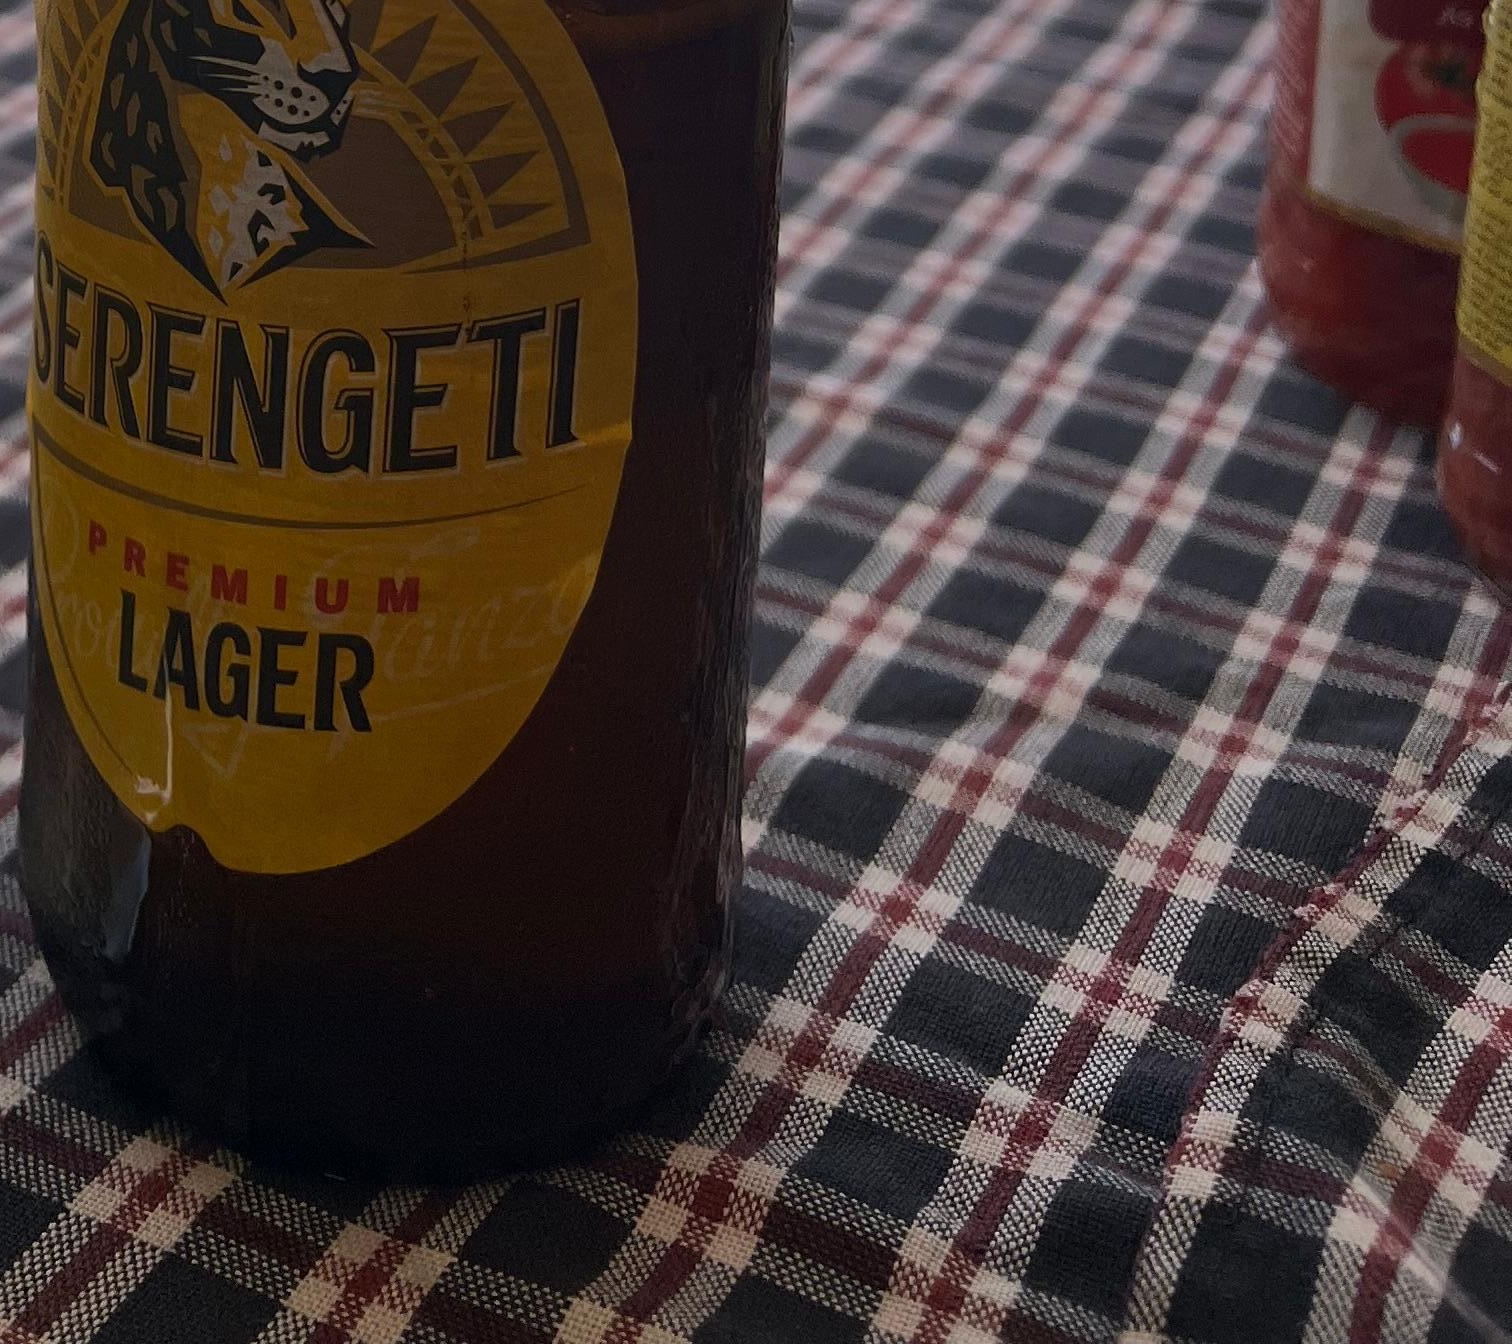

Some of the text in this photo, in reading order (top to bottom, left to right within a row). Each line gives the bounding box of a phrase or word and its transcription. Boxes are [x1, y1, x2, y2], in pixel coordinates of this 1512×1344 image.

[34, 232, 580, 475] SERENGETI
[88, 519, 421, 614] PREMIUM
[117, 590, 376, 733] LAGER
